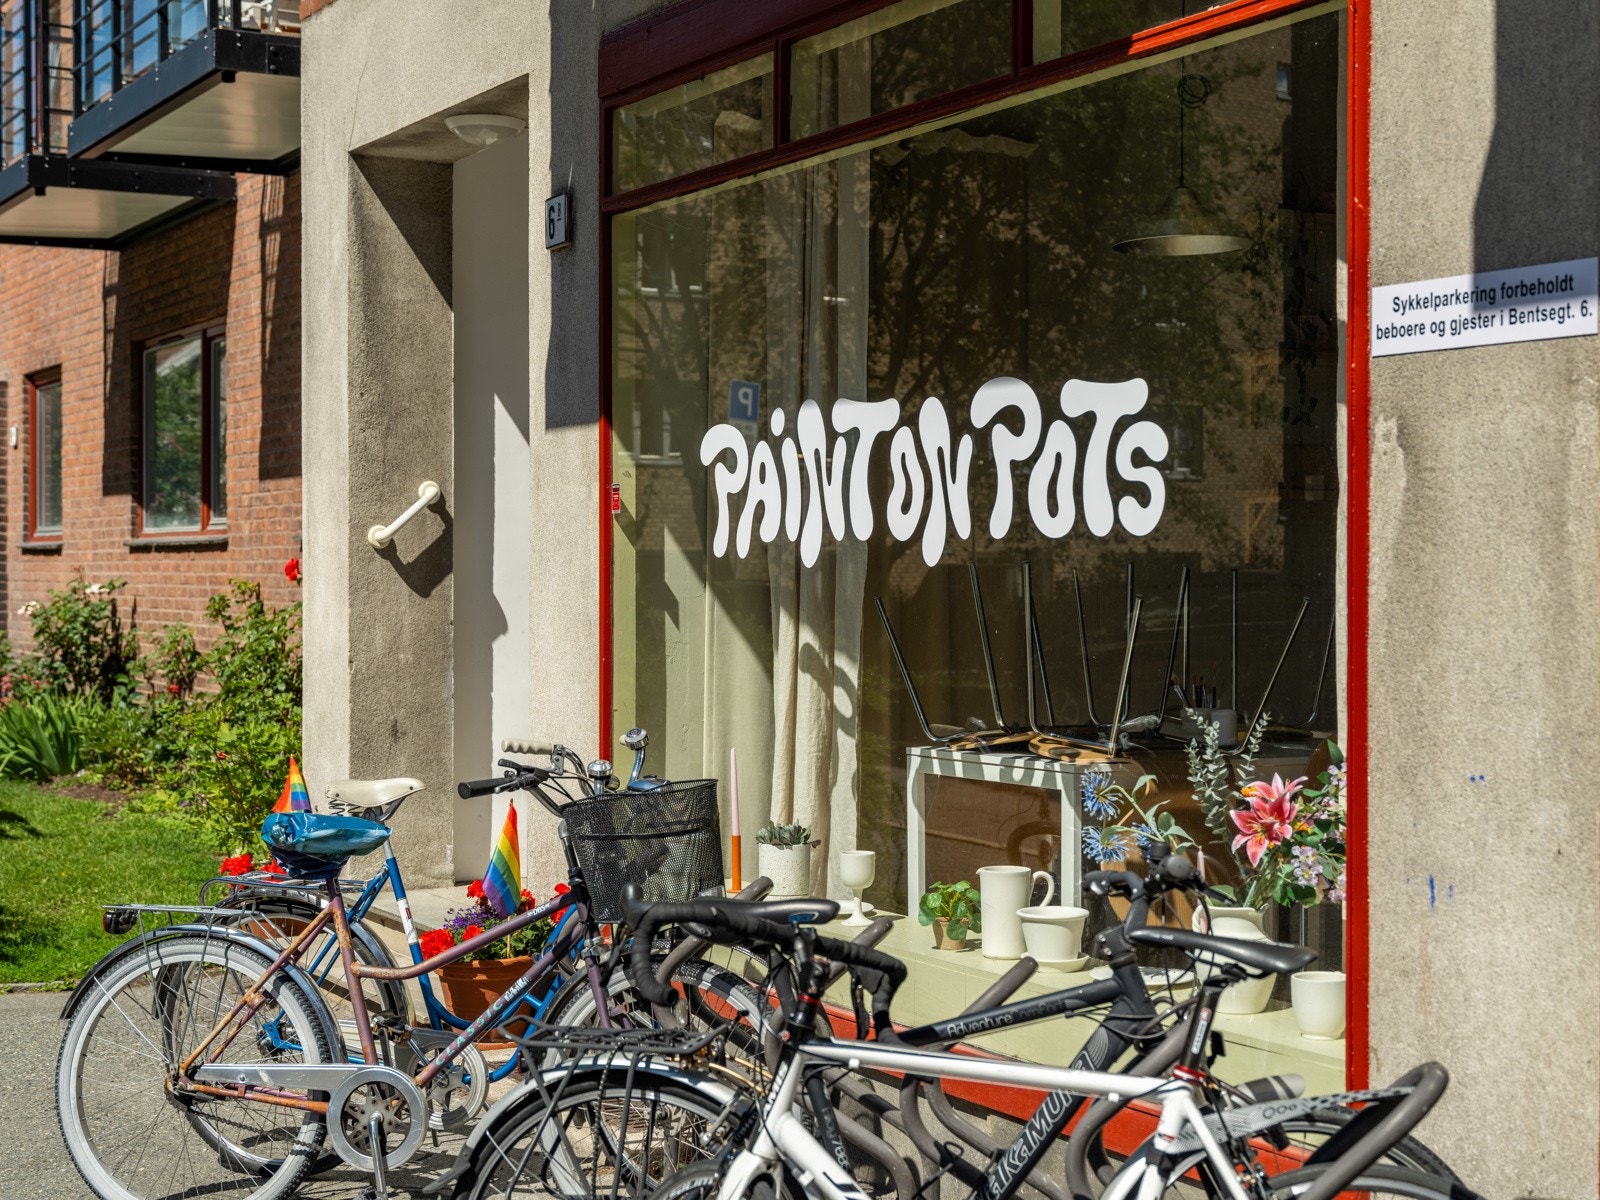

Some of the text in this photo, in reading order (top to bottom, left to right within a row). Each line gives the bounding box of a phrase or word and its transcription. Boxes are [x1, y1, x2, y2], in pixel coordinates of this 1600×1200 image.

[1392, 274, 1574, 316] Sykkelparkering forbeholdt
[1376, 299, 1593, 340] beboere og gjester i Bentsegt. 6.
[886, 396, 973, 567] ON
[970, 376, 1169, 539] POTS
[436, 1000, 503, 1067] CLASSIC
[946, 1013, 1013, 1038] Adventure
